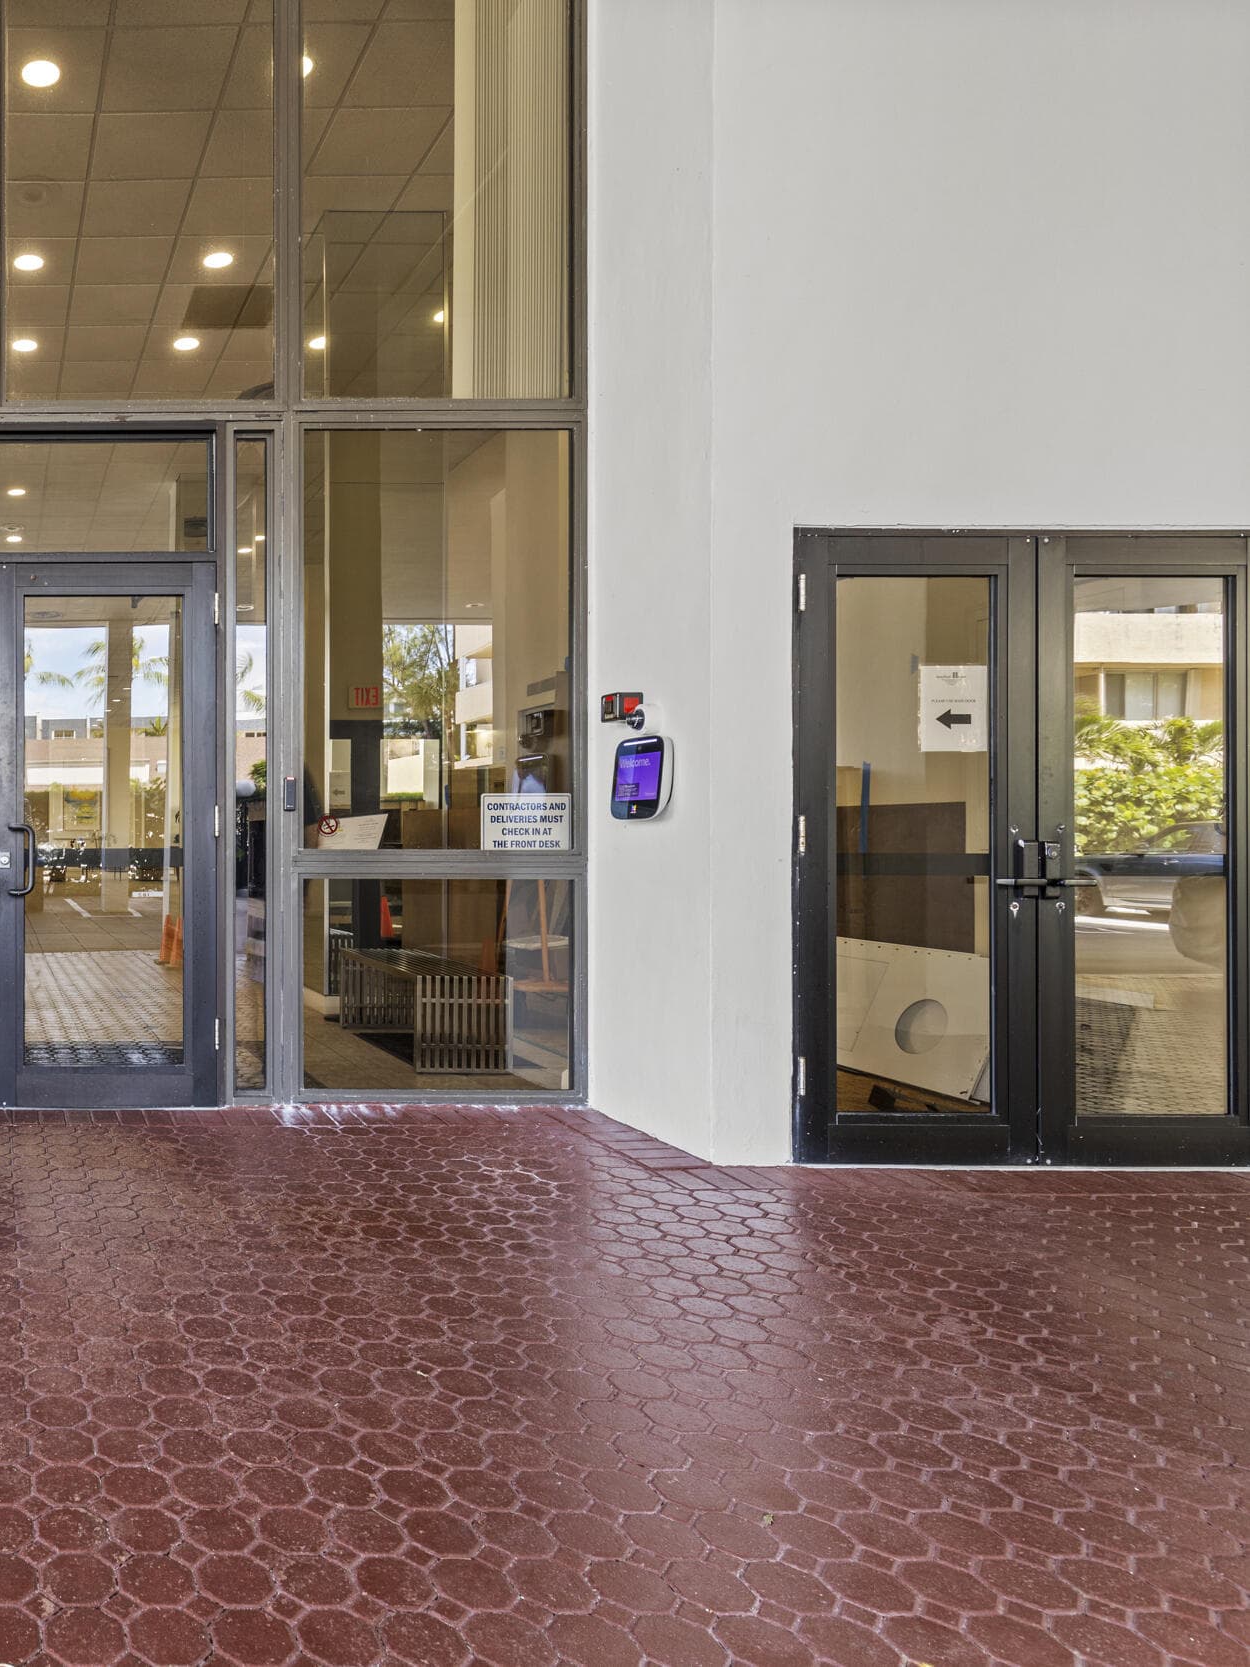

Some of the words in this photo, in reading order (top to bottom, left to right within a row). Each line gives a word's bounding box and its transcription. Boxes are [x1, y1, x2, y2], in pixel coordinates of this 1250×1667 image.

[487, 802, 547, 811] CONTRACTORS
[549, 802, 566, 811] AND
[490, 815, 537, 824] DELIVERIES
[540, 815, 563, 823] MUST
[502, 827, 530, 836] CHECK
[532, 828, 540, 836] IN
[542, 827, 552, 836] AT
[493, 840, 508, 848] THE
[511, 840, 537, 848] FRONT
[539, 840, 561, 848] DESK
